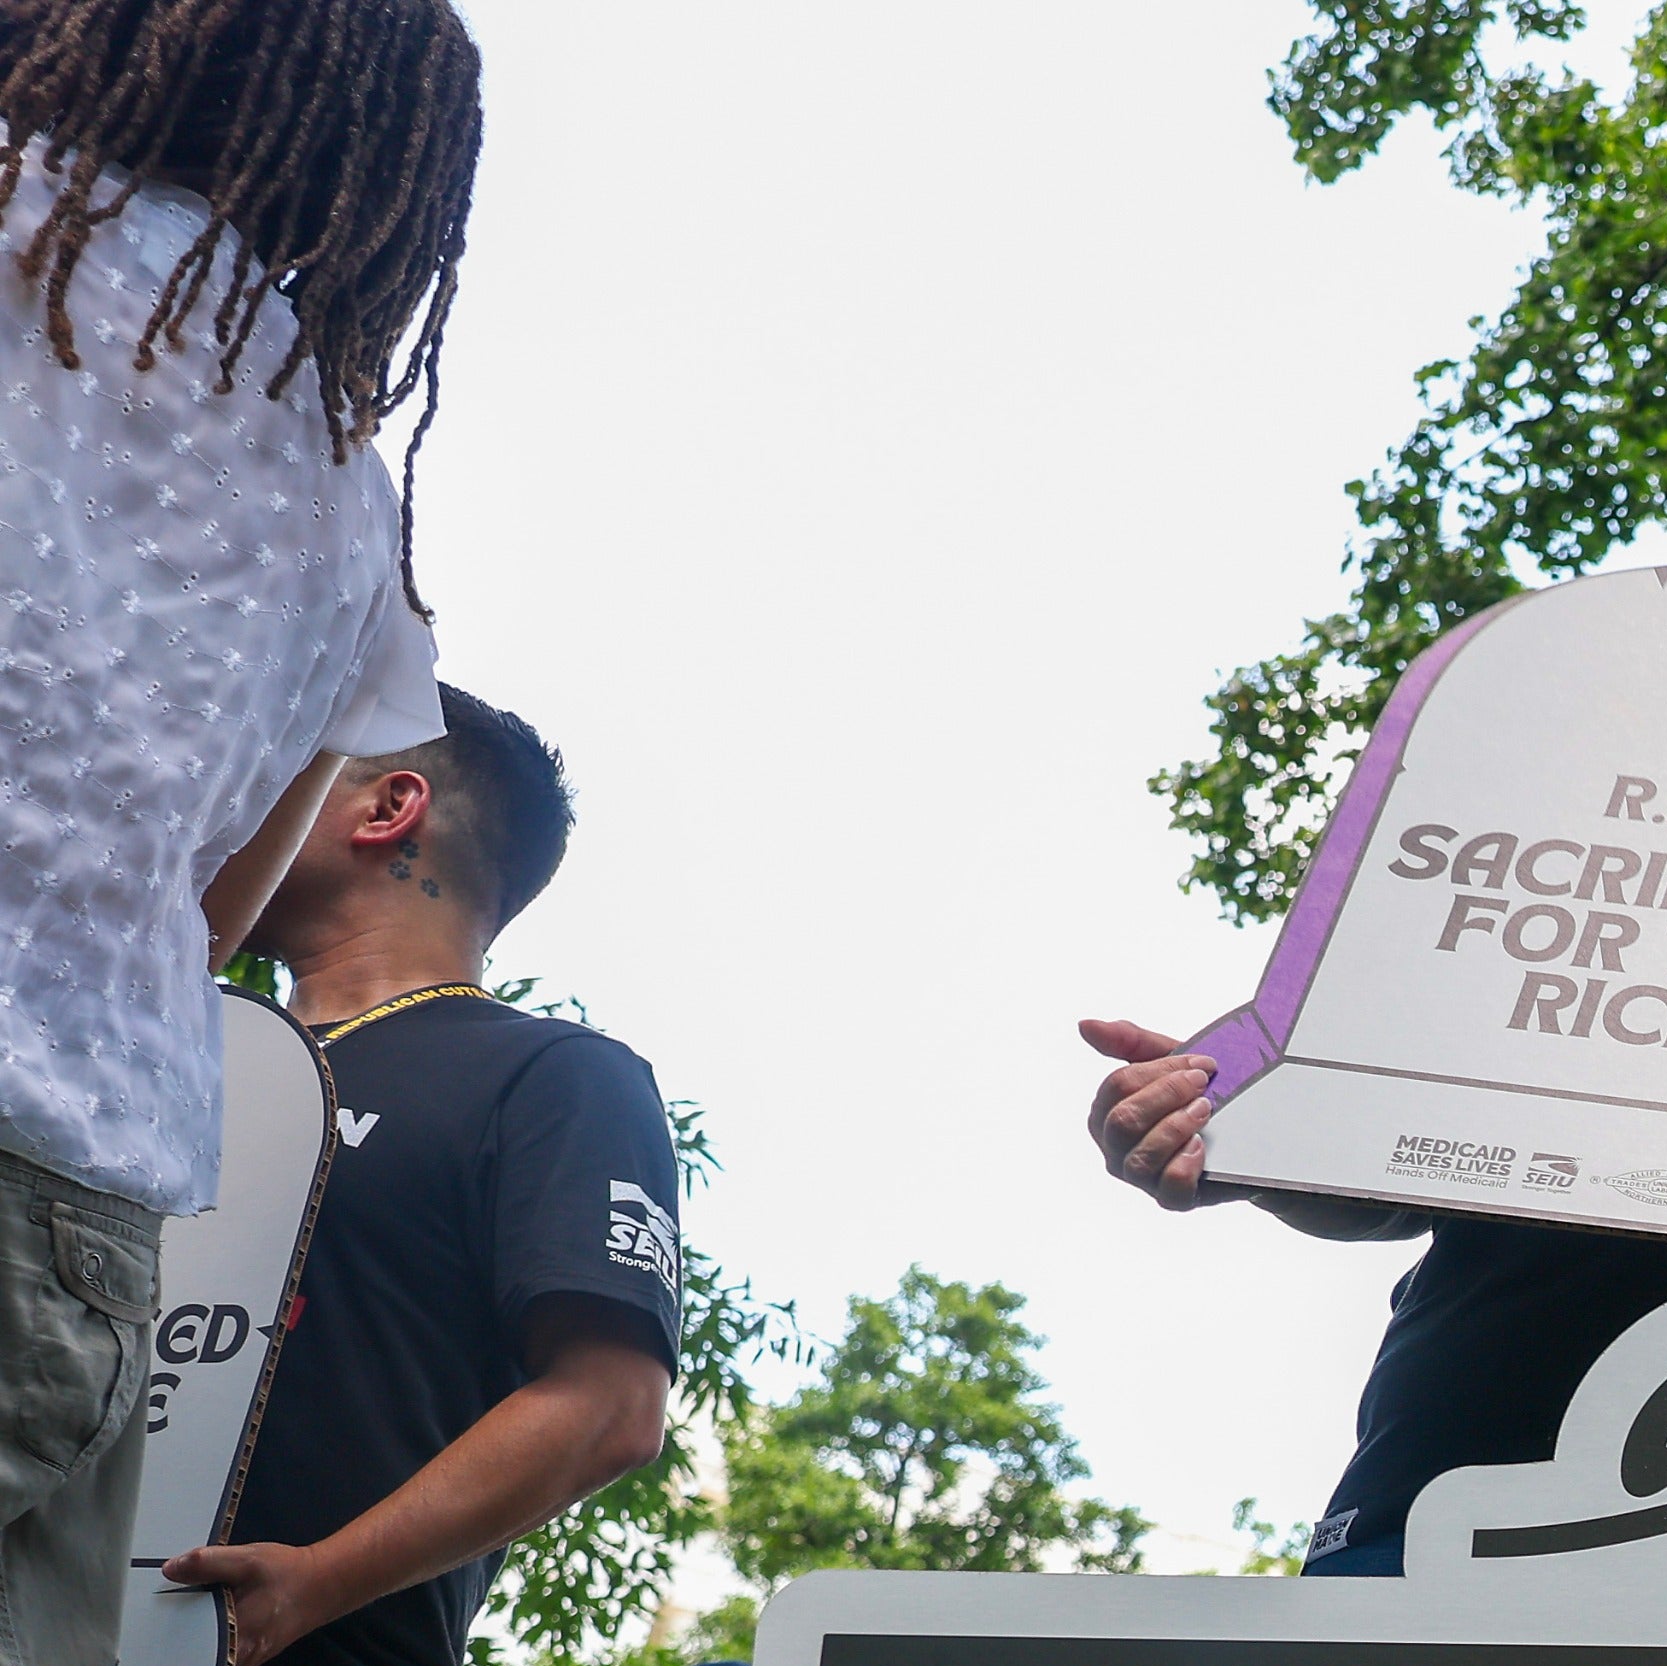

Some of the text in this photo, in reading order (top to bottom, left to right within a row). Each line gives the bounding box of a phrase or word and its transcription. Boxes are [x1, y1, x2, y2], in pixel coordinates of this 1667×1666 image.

[1434, 892, 1642, 974] FOR
[1395, 1135, 1517, 1163] MEDICAID
[1390, 1151, 1512, 1176] SAVES LIVES
[1385, 1165, 1425, 1180] Hands
[1427, 1169, 1450, 1182] Off
[1450, 1173, 1508, 1189] Medicaid
[1522, 1172, 1577, 1188] SEIU
